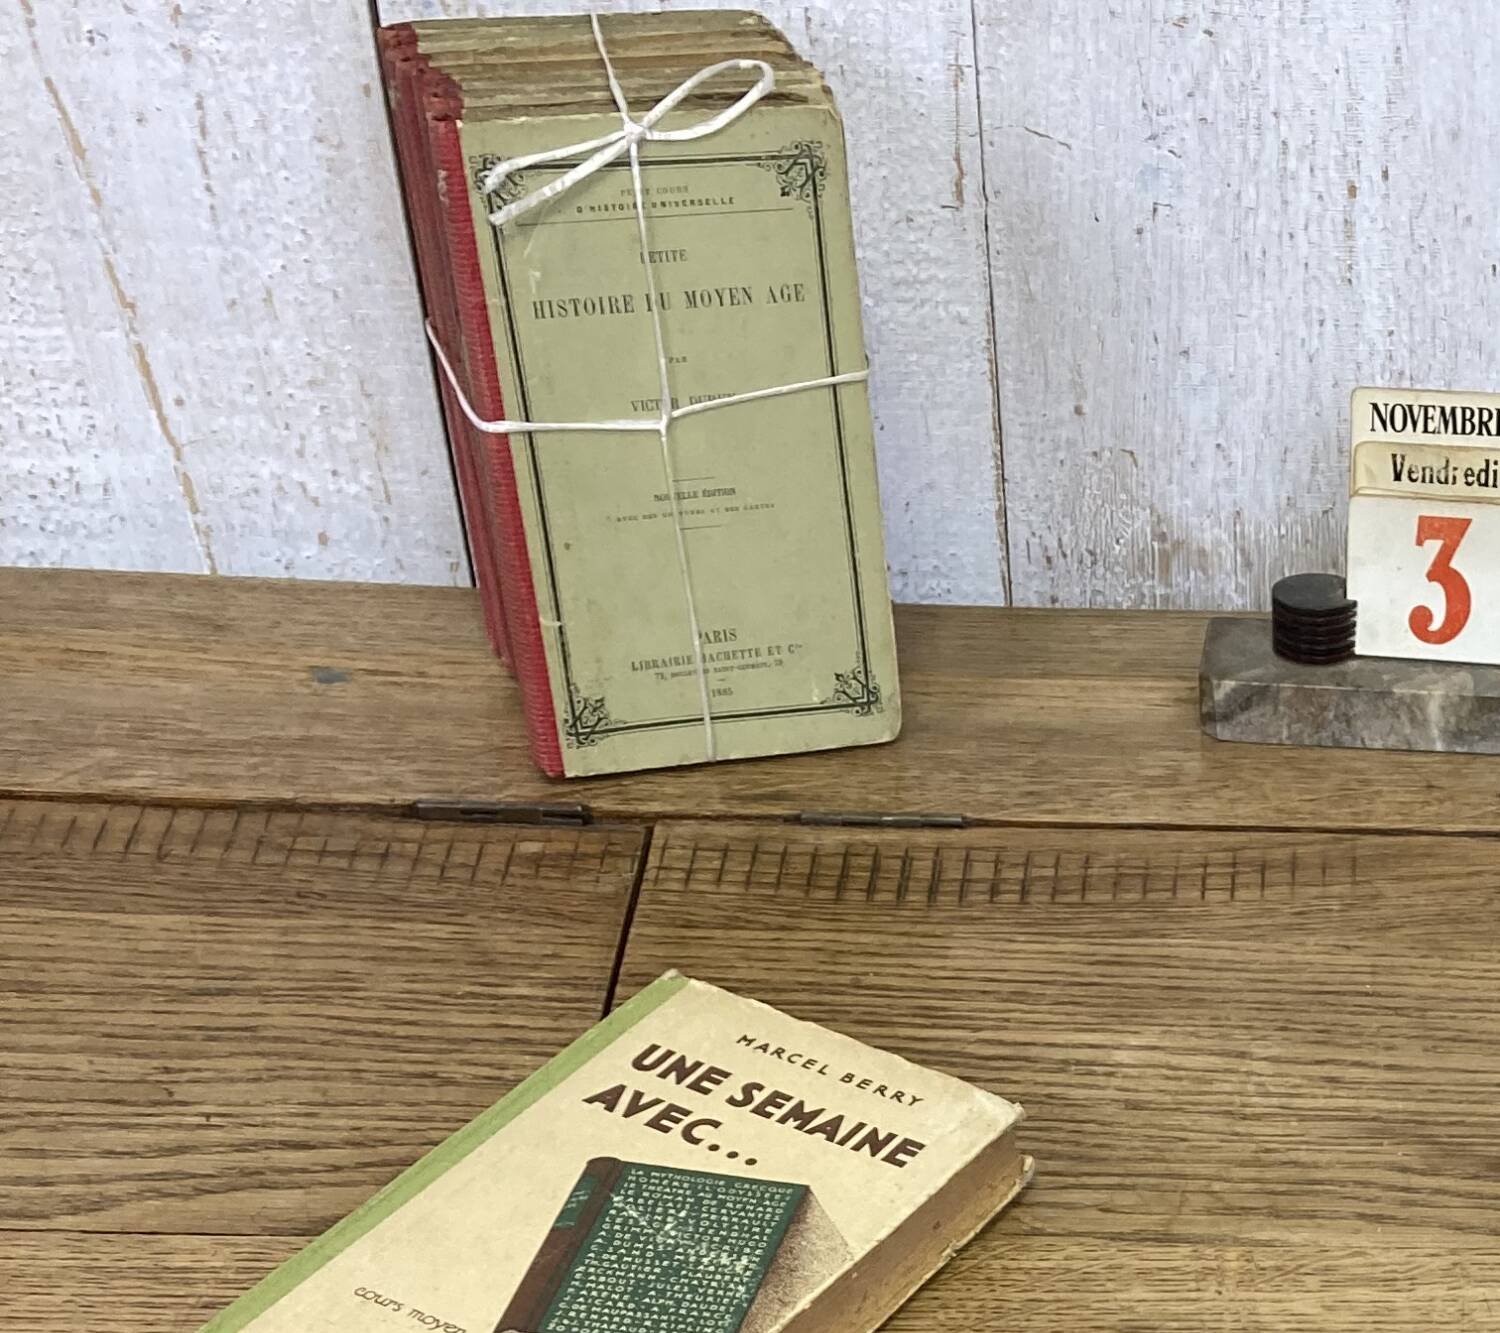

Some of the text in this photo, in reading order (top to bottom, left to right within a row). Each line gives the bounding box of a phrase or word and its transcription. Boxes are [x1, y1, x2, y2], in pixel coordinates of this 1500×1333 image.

[532, 294, 636, 320] HISTOIRE
[685, 285, 753, 309] MOYEN
[766, 283, 806, 305] AGE
[630, 396, 680, 412] VICTR
[1390, 453, 1499, 489] Vendredi
[1408, 514, 1474, 646] 3
[767, 645, 782, 656] ET
[736, 1034, 925, 1107] MARCEL BERRY
[631, 1043, 927, 1169] UNE SEMAINE
[581, 1083, 758, 1167] AVEC...
[353, 1286, 401, 1312] cours
